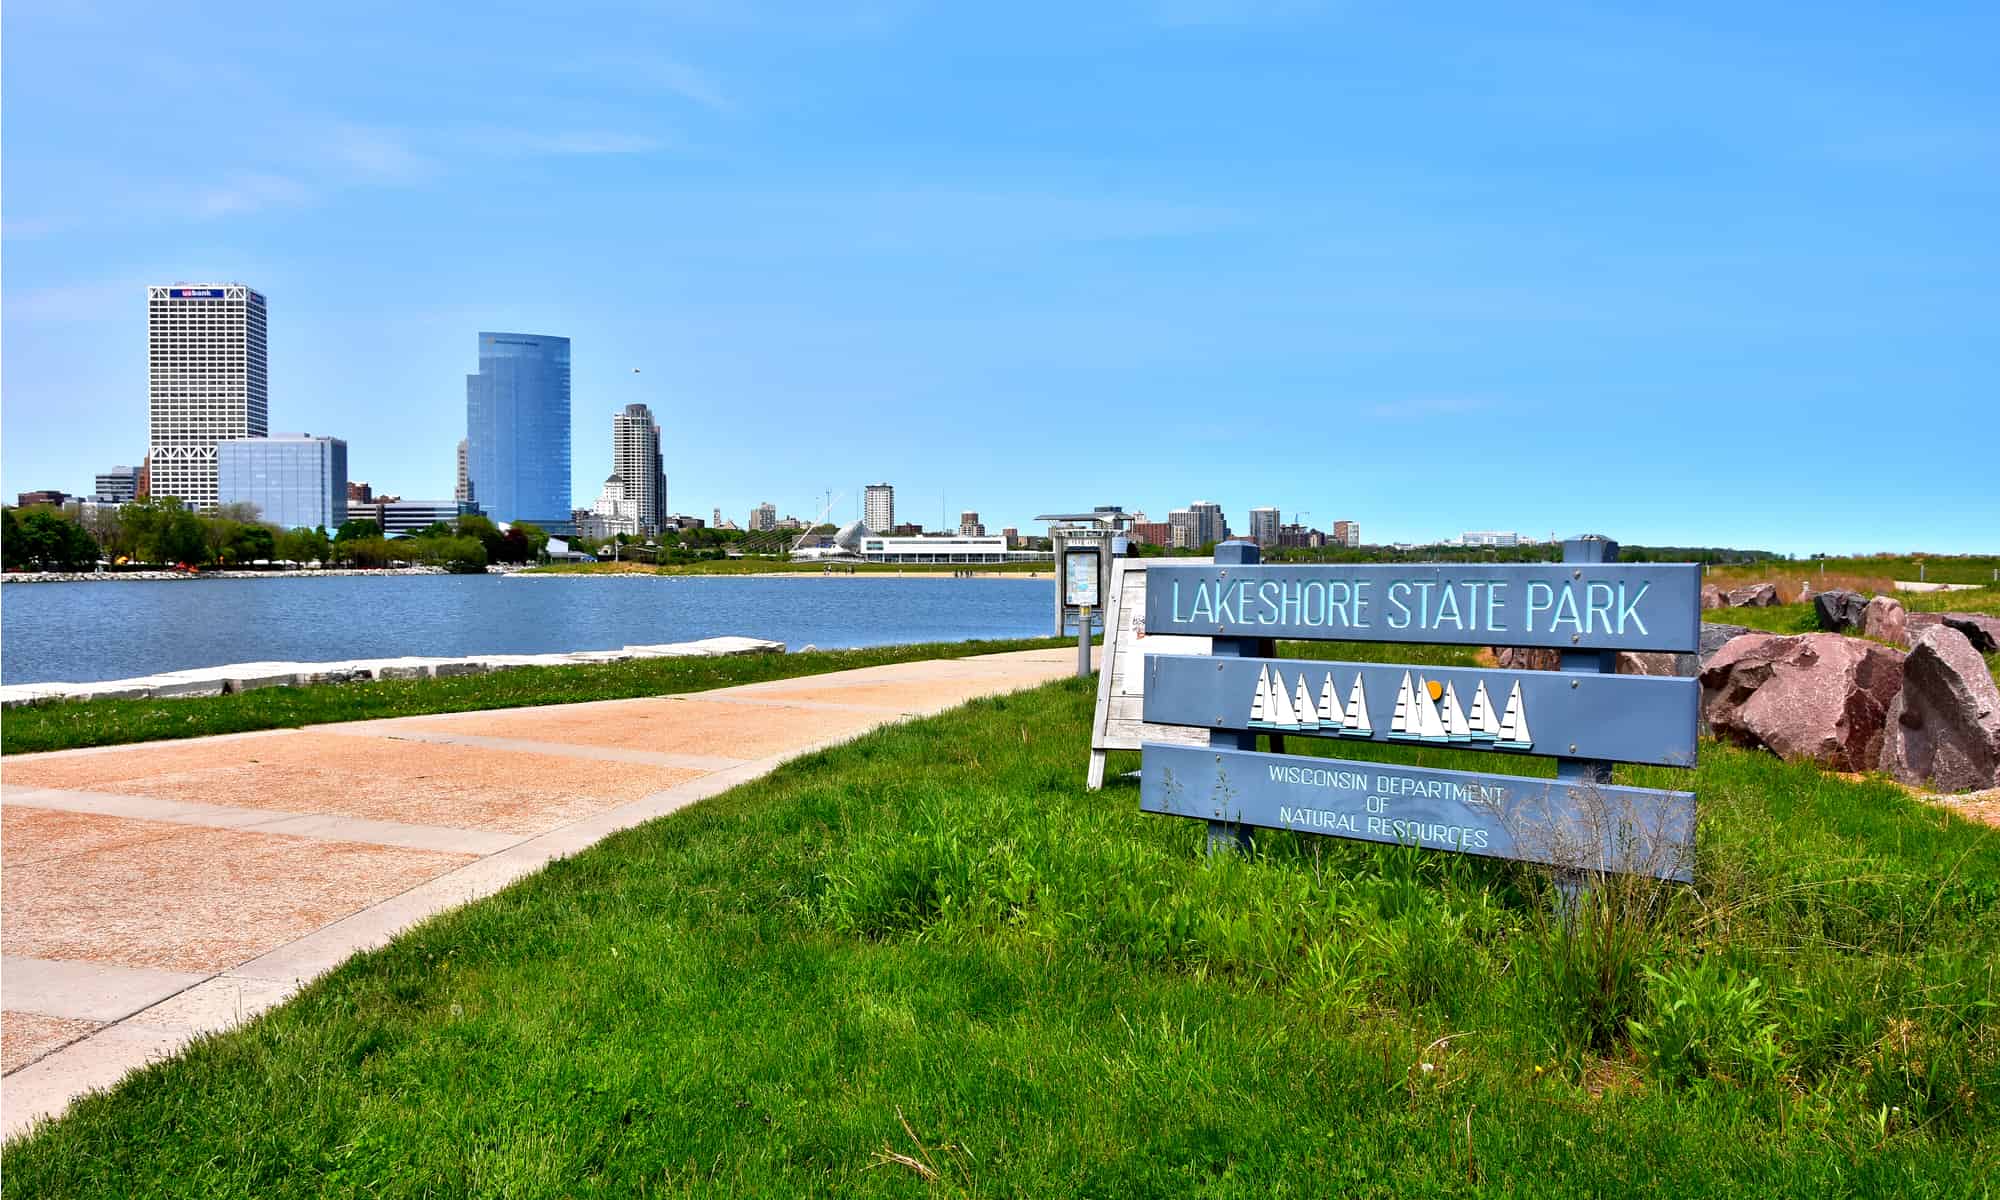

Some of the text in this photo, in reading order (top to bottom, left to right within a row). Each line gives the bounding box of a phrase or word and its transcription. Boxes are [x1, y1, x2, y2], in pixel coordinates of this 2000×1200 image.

[1172, 579, 1371, 628] LAKESHORE
[1387, 580, 1509, 632] STATE
[1526, 580, 1650, 635] PARK
[1268, 765, 1505, 804] WISCONSIN DEPARTMENT
[1366, 796, 1391, 814] OF
[1280, 806, 1489, 848] NATURAL RESOURCES
